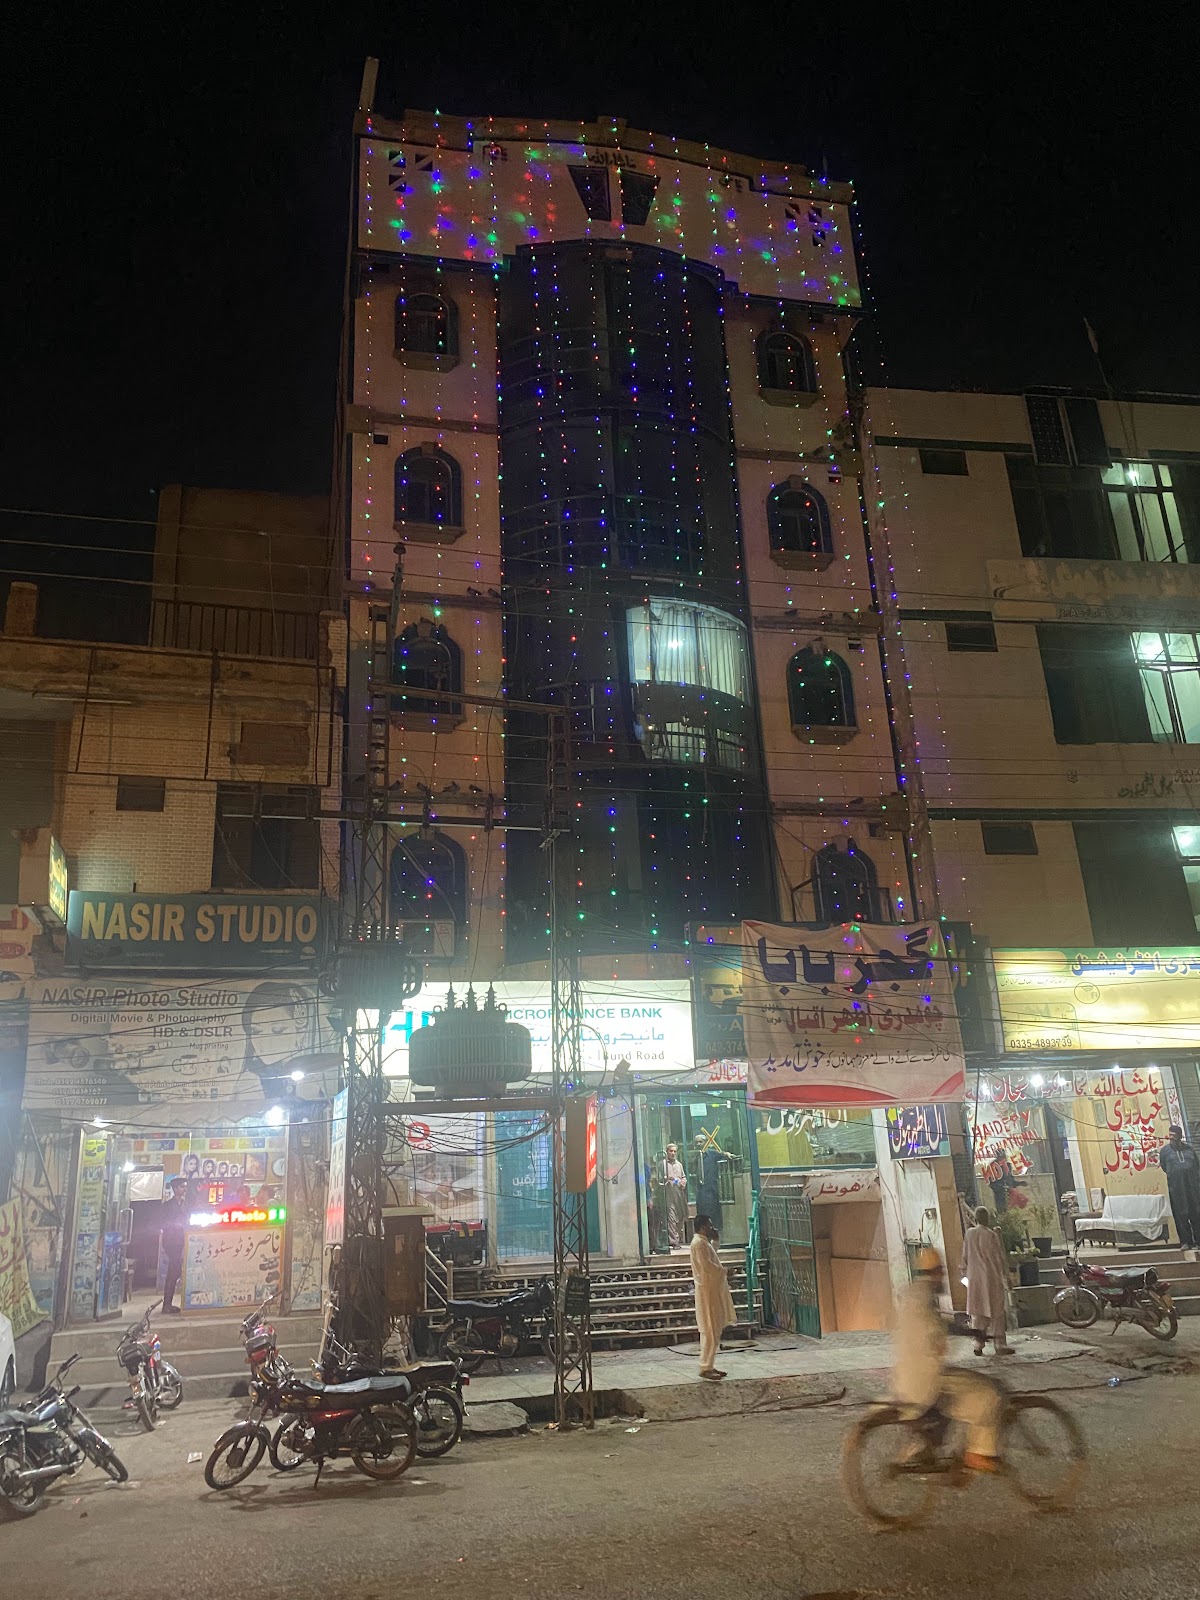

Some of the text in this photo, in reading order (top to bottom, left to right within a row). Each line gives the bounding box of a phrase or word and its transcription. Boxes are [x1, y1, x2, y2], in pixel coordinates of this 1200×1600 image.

[81, 902, 318, 943] NASIR STUDIO
[41, 987, 239, 1007] NASIR Photo Studio
[71, 1013, 227, 1025] Digital Movie & Photography
[503, 1007, 663, 1020] ICROFNANCE BANK
[153, 1026, 233, 1038] HD & DSLR
[705, 1040, 747, 1055] 042-374
[1010, 1037, 1072, 1049] 0335-4893739
[636, 1050, 665, 1061] Road
[1106, 1099, 1162, 1132] حیدری
[247, 1231, 280, 1261] ناصر
